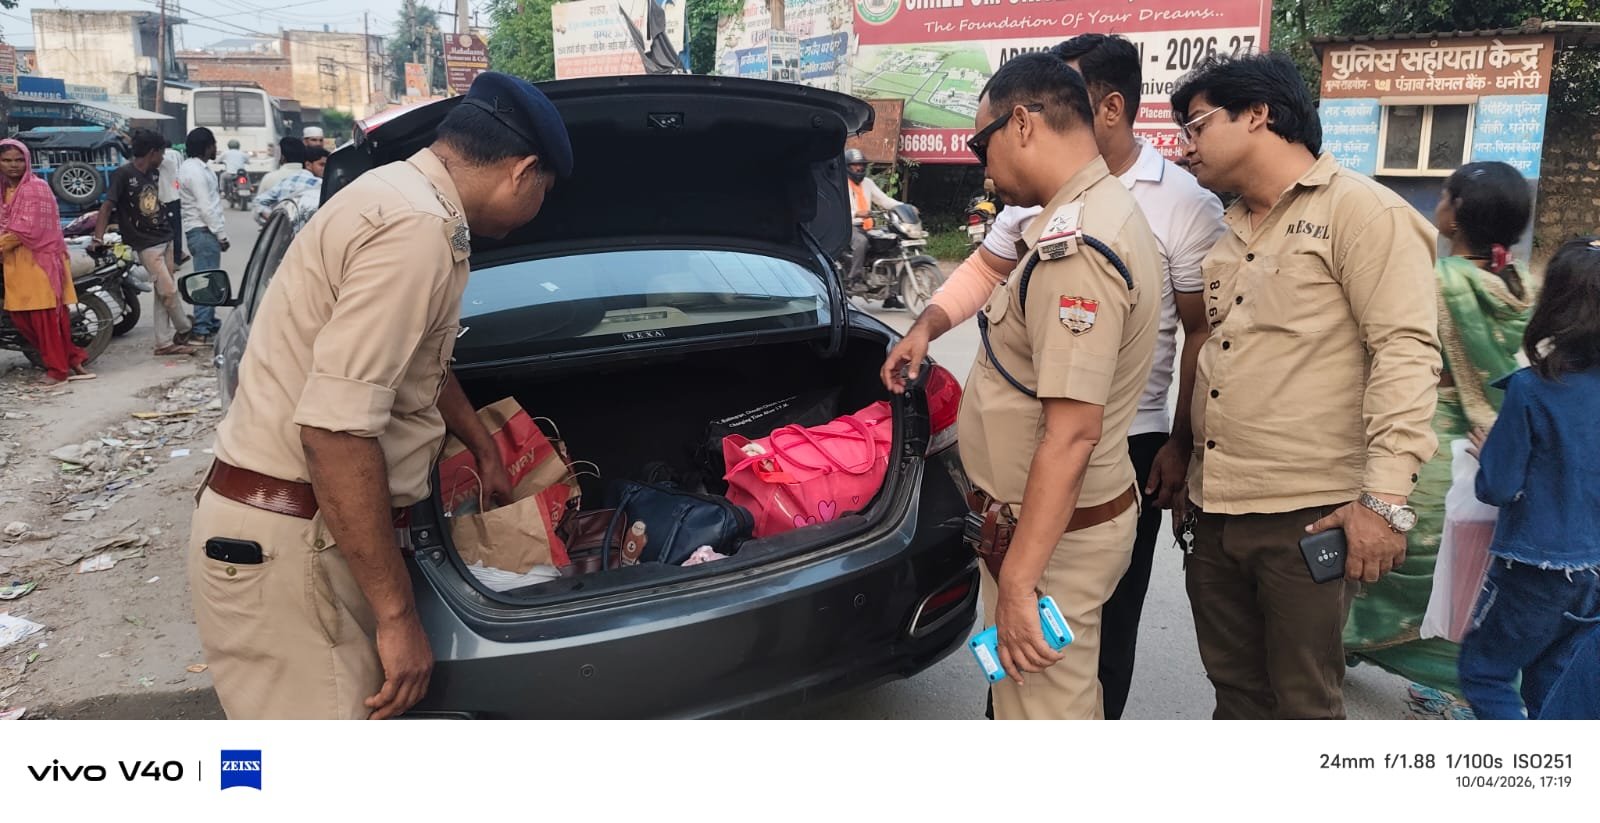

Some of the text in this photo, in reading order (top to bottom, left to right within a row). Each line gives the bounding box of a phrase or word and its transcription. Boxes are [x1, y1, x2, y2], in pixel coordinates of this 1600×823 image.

[924, 8, 1225, 33] The Foundation Of Your Dreams...
[1330, 44, 1400, 80] पुलिस
[1489, 39, 1544, 71] केन्द्र
[1495, 70, 1542, 89] धनौरी
[1140, 106, 1171, 118] Placem
[626, 331, 664, 340] NEXA
